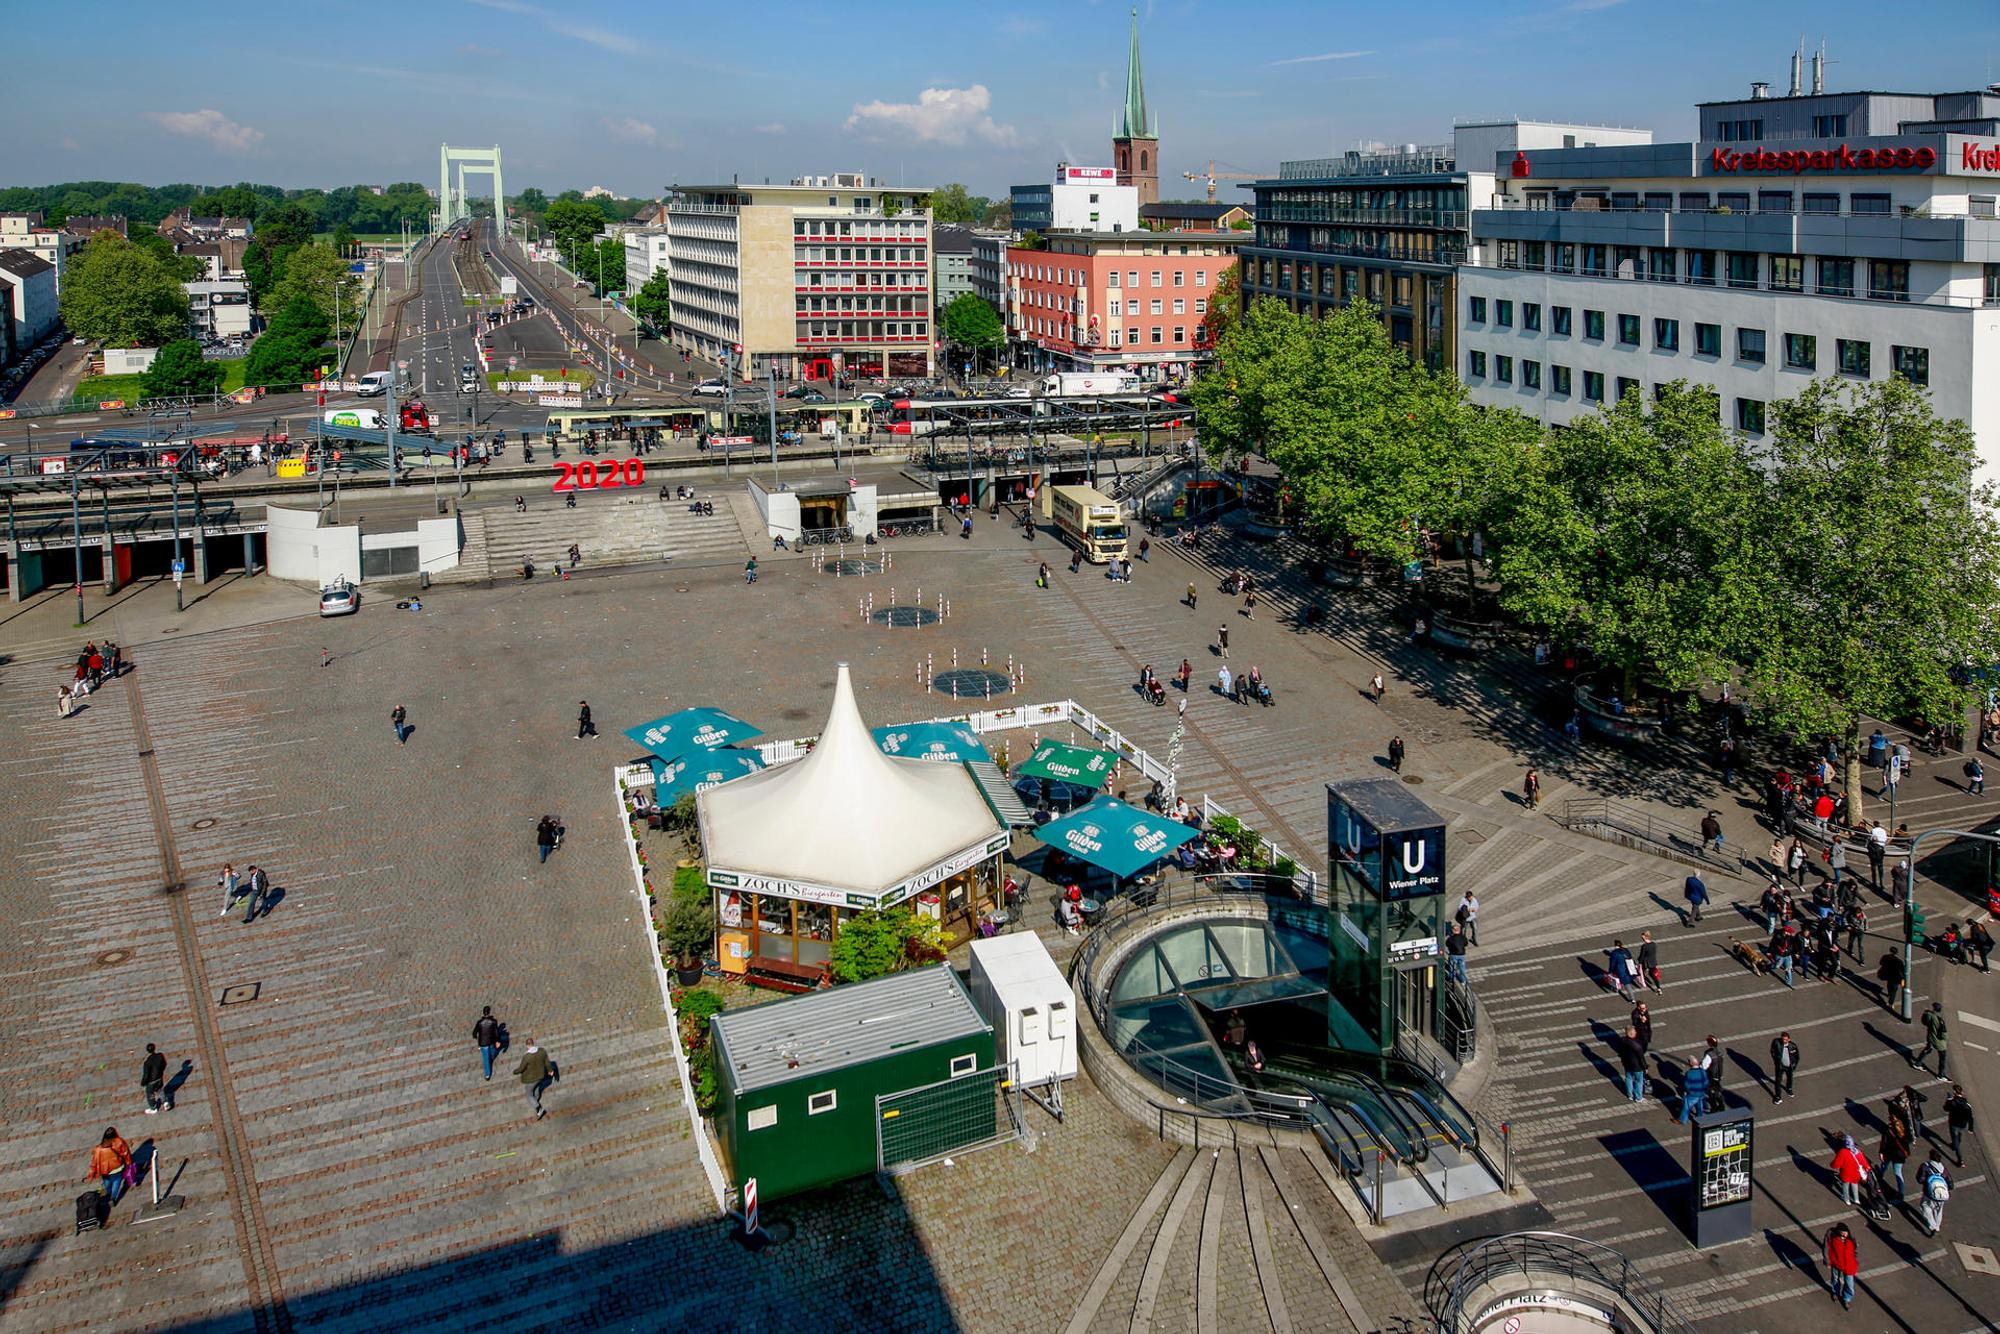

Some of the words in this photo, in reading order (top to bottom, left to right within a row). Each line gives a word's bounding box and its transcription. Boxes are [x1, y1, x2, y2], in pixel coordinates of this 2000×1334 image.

[1713, 144, 1937, 173] Kreissparkasse
[1080, 169, 1102, 177] REWE
[552, 457, 645, 491] 2020
[693, 729, 729, 744] Gilden
[1047, 762, 1080, 775] Gilden
[1065, 829, 1102, 851] Gilden
[1134, 830, 1167, 852] Gilden
[1403, 839, 1425, 874] U
[910, 863, 954, 892] ZOCH'S
[1389, 879, 1417, 889] Wiener
[1419, 876, 1439, 885] Platz
[744, 878, 800, 895] ZOCH'S
[801, 887, 842, 900] Biergarten
